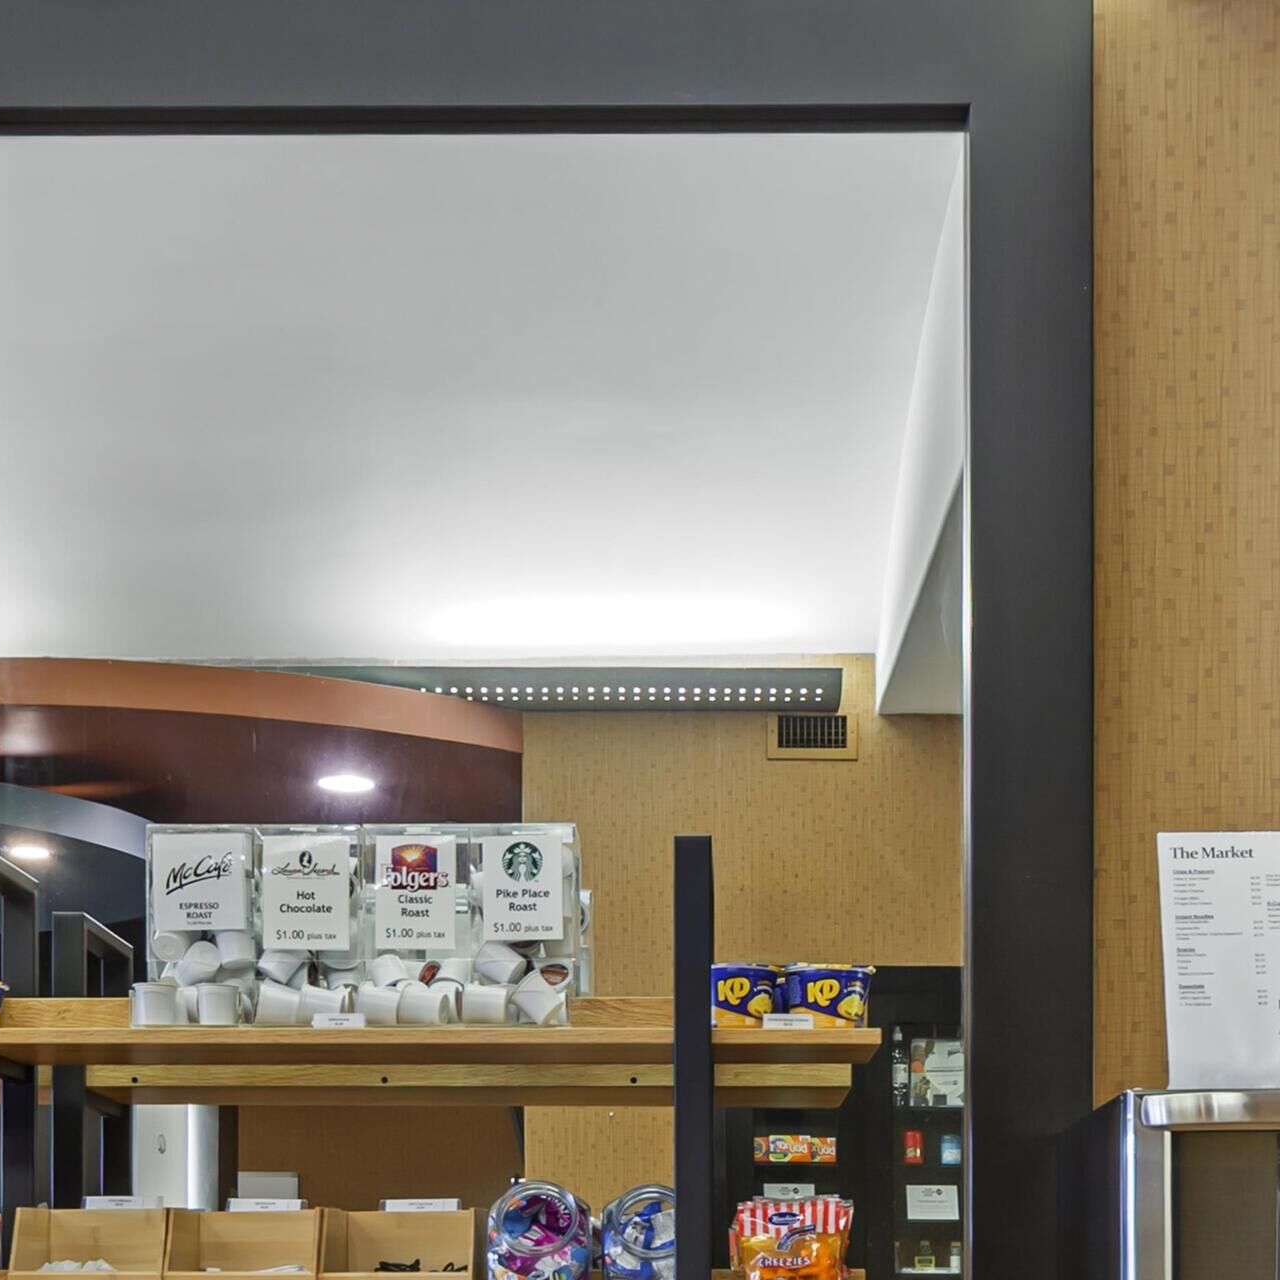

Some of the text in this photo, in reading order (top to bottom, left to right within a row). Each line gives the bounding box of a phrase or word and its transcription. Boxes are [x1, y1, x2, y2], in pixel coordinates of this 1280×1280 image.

[1170, 845, 1254, 860] The Market
[381, 864, 449, 893] Folgers
[297, 890, 316, 900] Hot
[496, 888, 550, 898] Pike Place
[398, 894, 433, 904] Classic
[179, 902, 219, 910] ESPRESSO
[280, 903, 333, 914] Chocolate
[509, 902, 537, 912] Roast
[186, 911, 212, 919] ROAST
[401, 908, 430, 918] Roast
[493, 922, 522, 933] $1.00
[541, 925, 553, 933] tax
[276, 930, 304, 940] $1.00
[324, 932, 337, 940] tax
[385, 928, 414, 939] $1.00
[434, 931, 446, 939] tax
